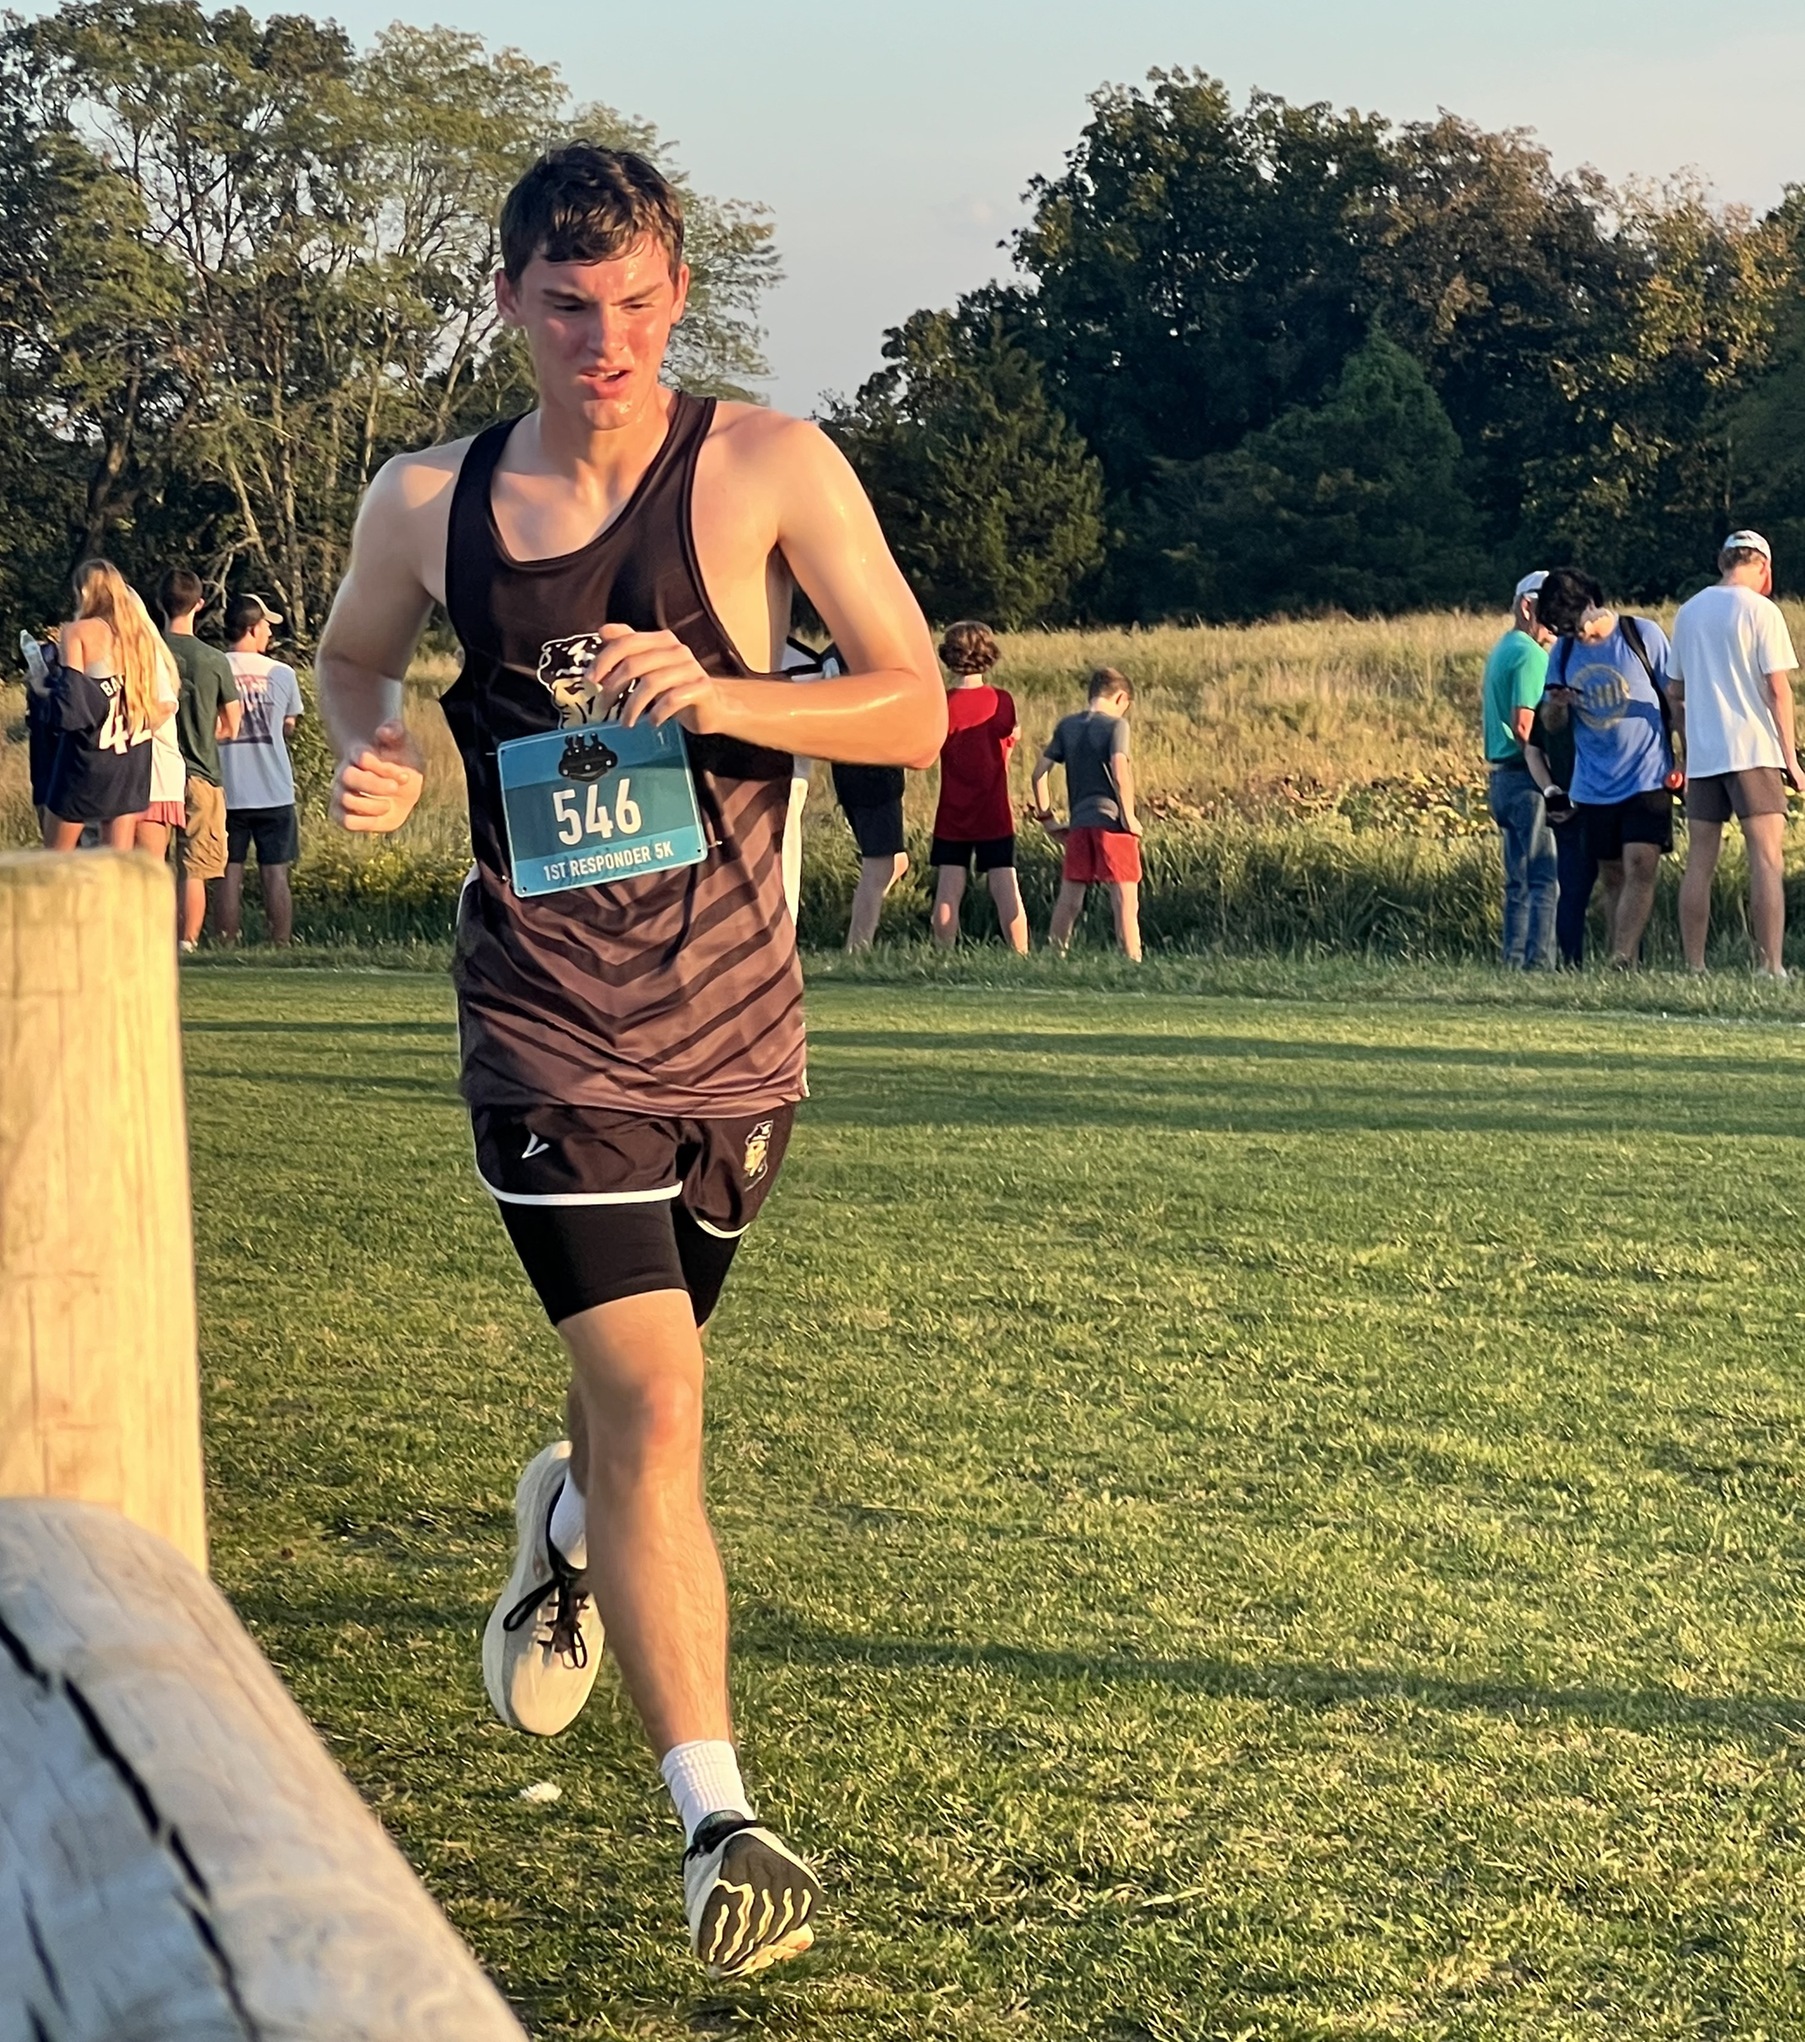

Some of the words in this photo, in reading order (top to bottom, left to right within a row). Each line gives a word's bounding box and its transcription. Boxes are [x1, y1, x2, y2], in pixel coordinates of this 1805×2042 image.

[553, 778, 642, 846] 546
[543, 861, 567, 882] 1ST
[569, 846, 651, 877] RESPONDER
[654, 841, 674, 859] 5K
